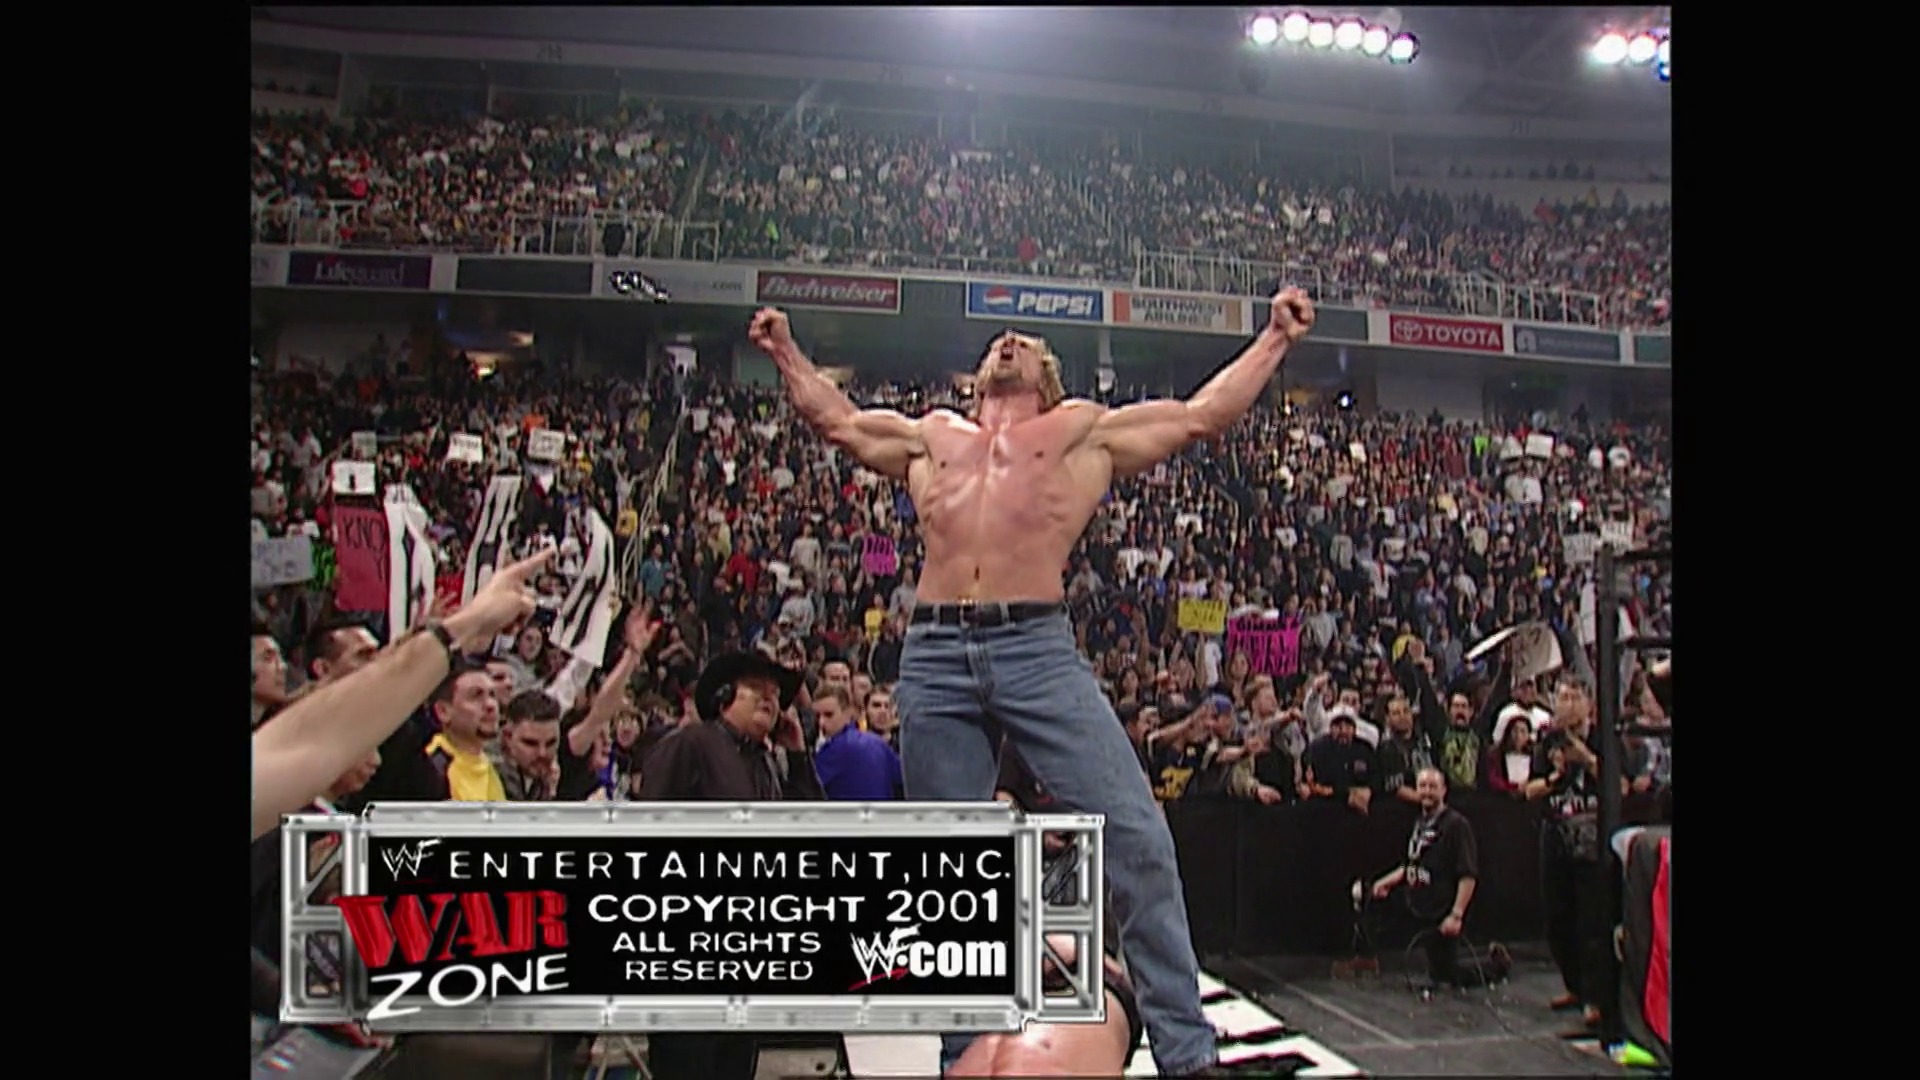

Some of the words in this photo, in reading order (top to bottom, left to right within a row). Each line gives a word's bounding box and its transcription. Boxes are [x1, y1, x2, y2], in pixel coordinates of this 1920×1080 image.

[764, 275, 895, 303] Budweiser
[1017, 291, 1094, 316] PEPSI
[1424, 323, 1501, 347] TOYOTA
